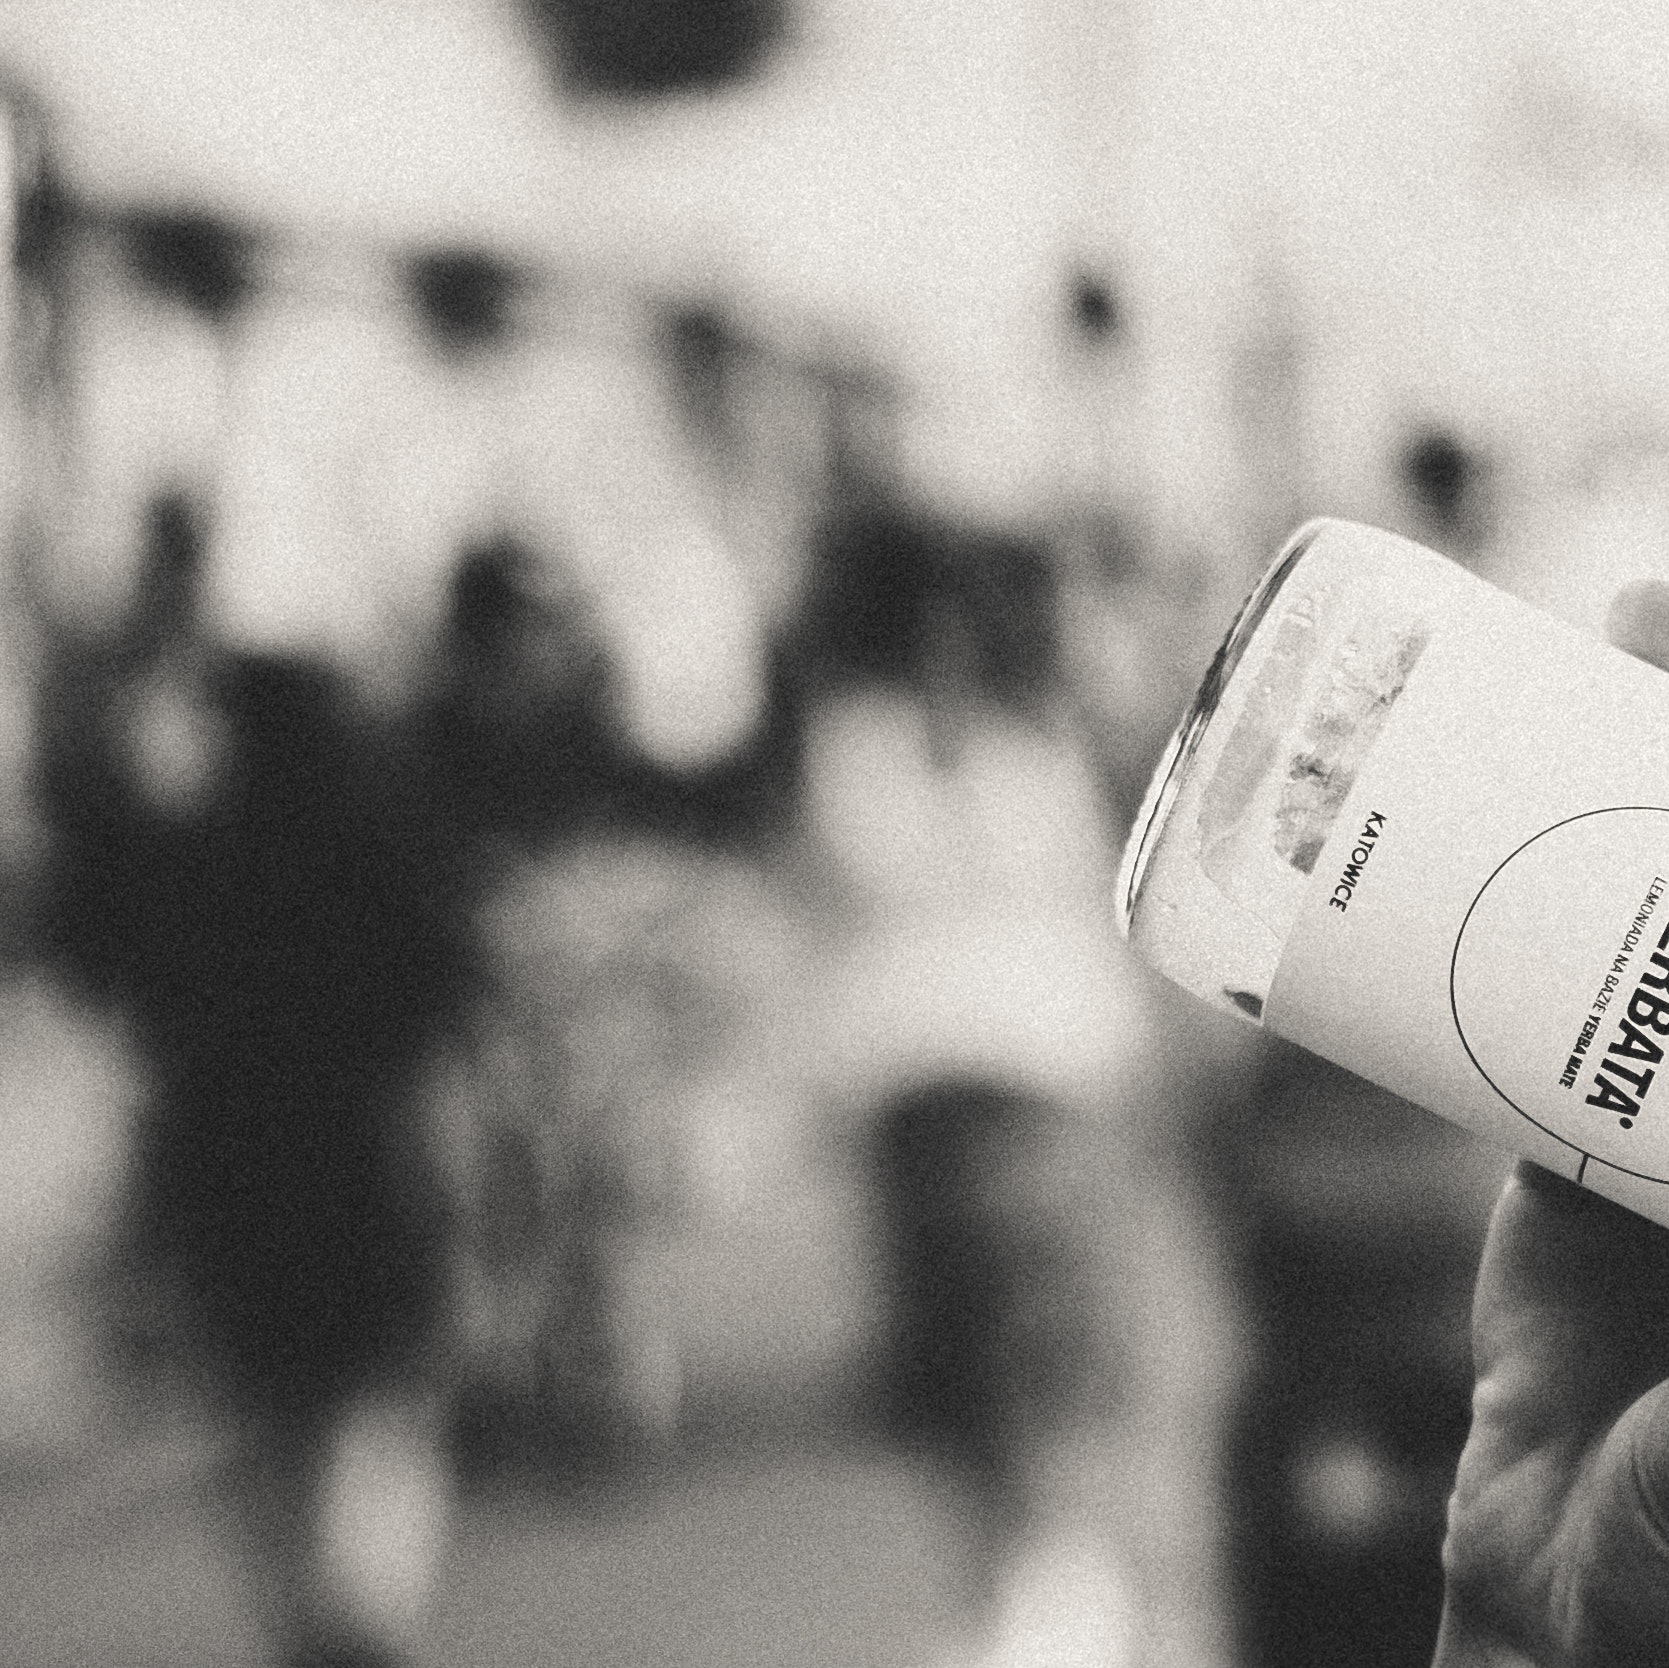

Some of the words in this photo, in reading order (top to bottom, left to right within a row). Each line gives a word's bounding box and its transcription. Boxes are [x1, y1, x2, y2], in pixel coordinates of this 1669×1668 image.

[1329, 810, 1387, 913] KATOWICE
[1620, 876, 1668, 953] LEMONIADA
[1611, 951, 1630, 973] NA
[1591, 974, 1620, 1016] BAZIE
[1573, 1014, 1602, 1056] YERBA
[1558, 1055, 1583, 1090] MATE
